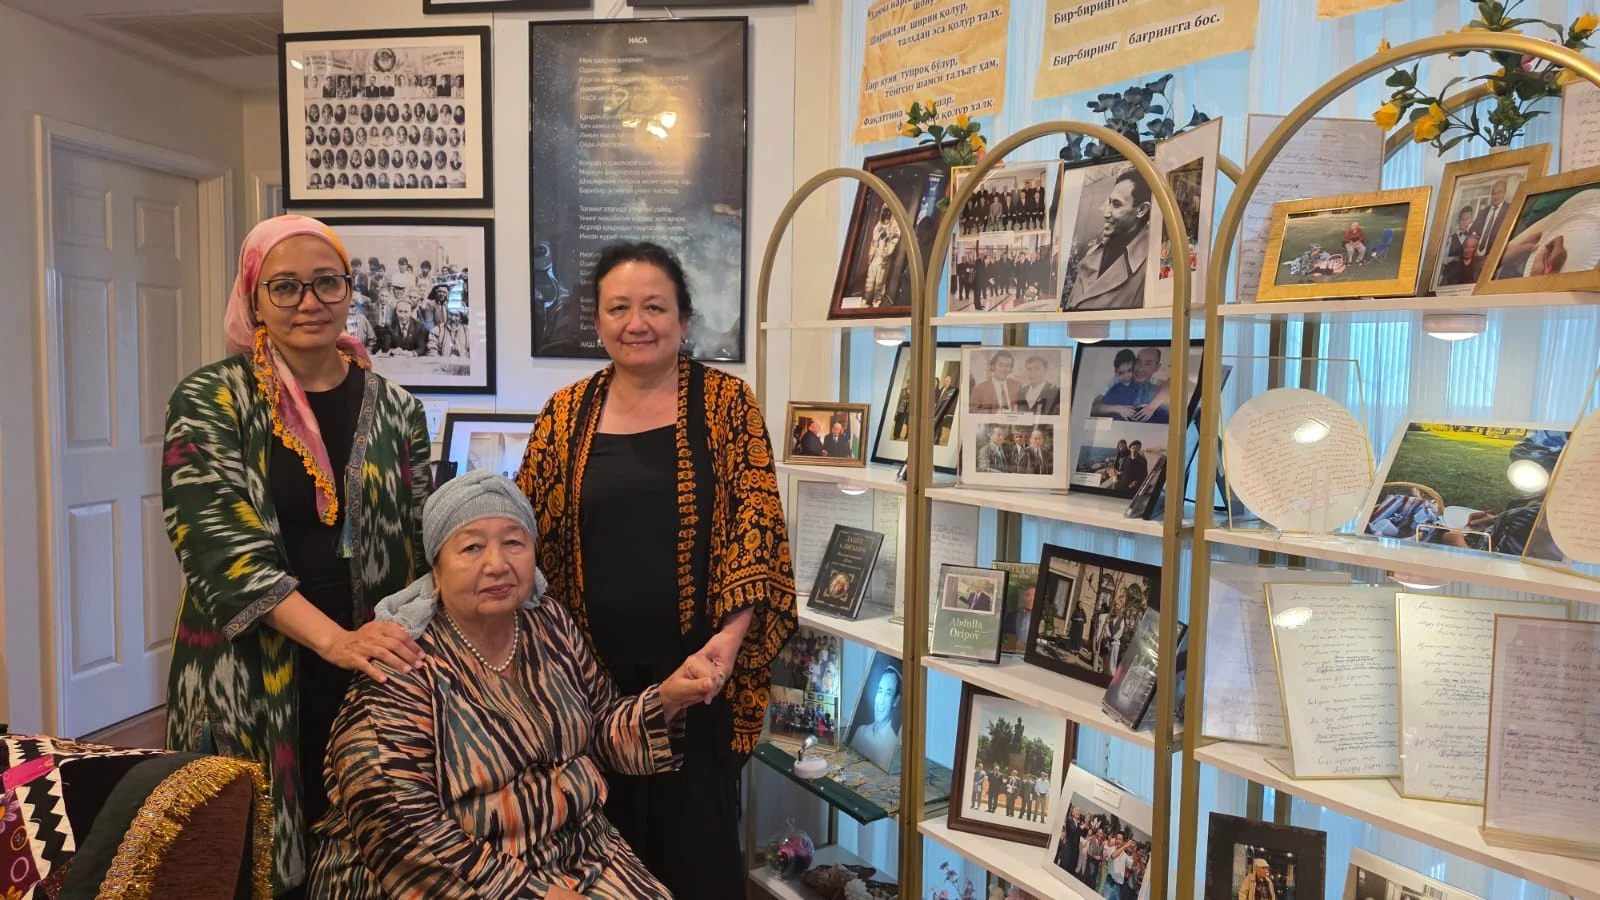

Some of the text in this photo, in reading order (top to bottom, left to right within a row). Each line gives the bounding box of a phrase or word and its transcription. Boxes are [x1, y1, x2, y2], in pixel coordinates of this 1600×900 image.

[910, 15, 937, 30] ширин
[932, 25, 945, 36] эса
[948, 17, 975, 32] қолур
[977, 8, 1003, 23] талх.
[628, 36, 648, 44] НАСА
[1053, 41, 1118, 67] Бир-биринг
[1194, 13, 1221, 28] бос.
[900, 64, 930, 79] тупроқ
[949, 617, 983, 629] Abdulla
[949, 628, 980, 641] Oripov
